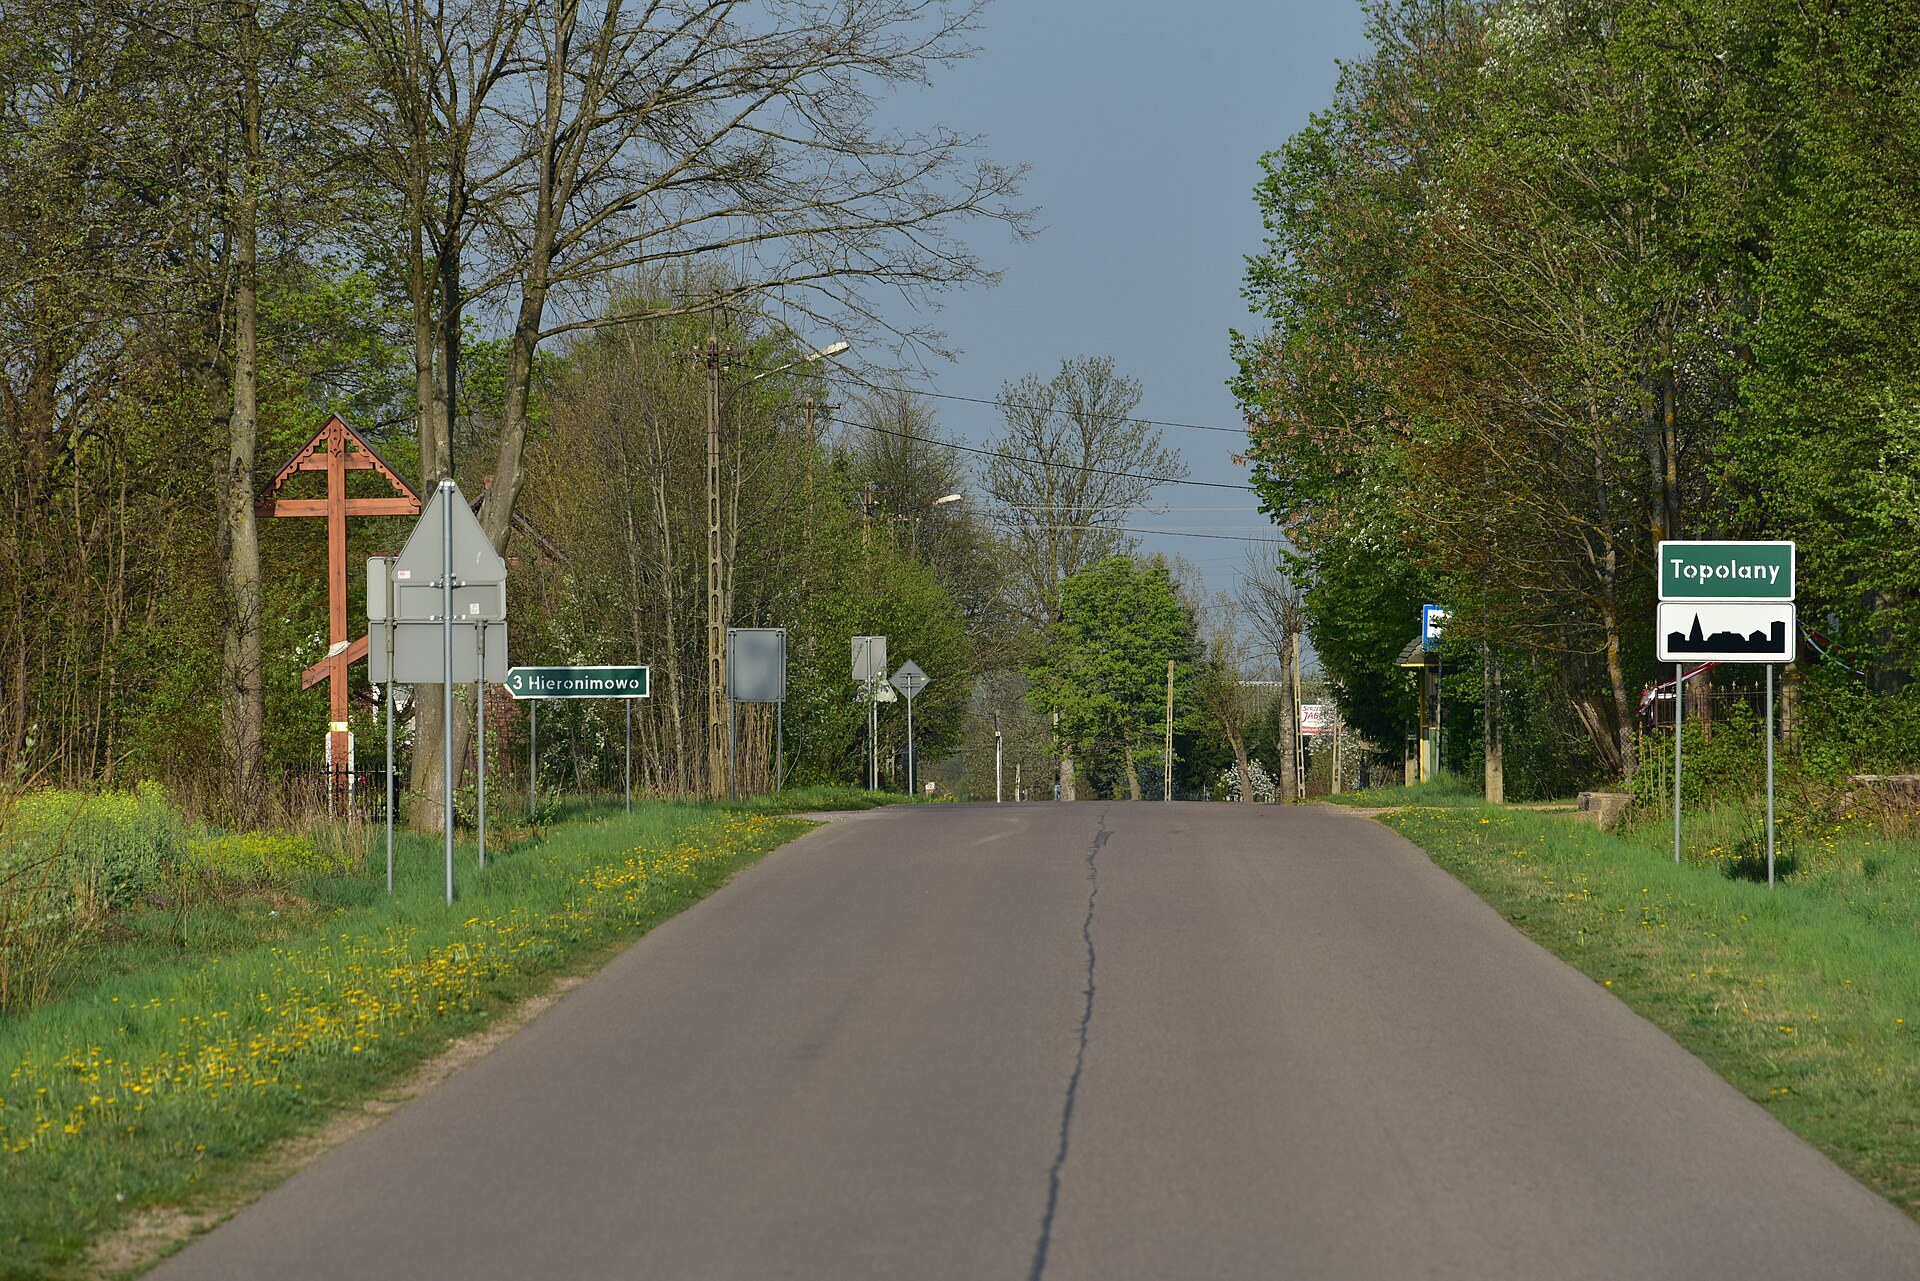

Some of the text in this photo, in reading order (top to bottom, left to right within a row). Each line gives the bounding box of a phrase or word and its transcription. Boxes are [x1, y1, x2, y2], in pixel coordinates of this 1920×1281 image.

[1670, 559, 1780, 584] Topolany
[513, 675, 639, 690] 3 Hieronimowo
